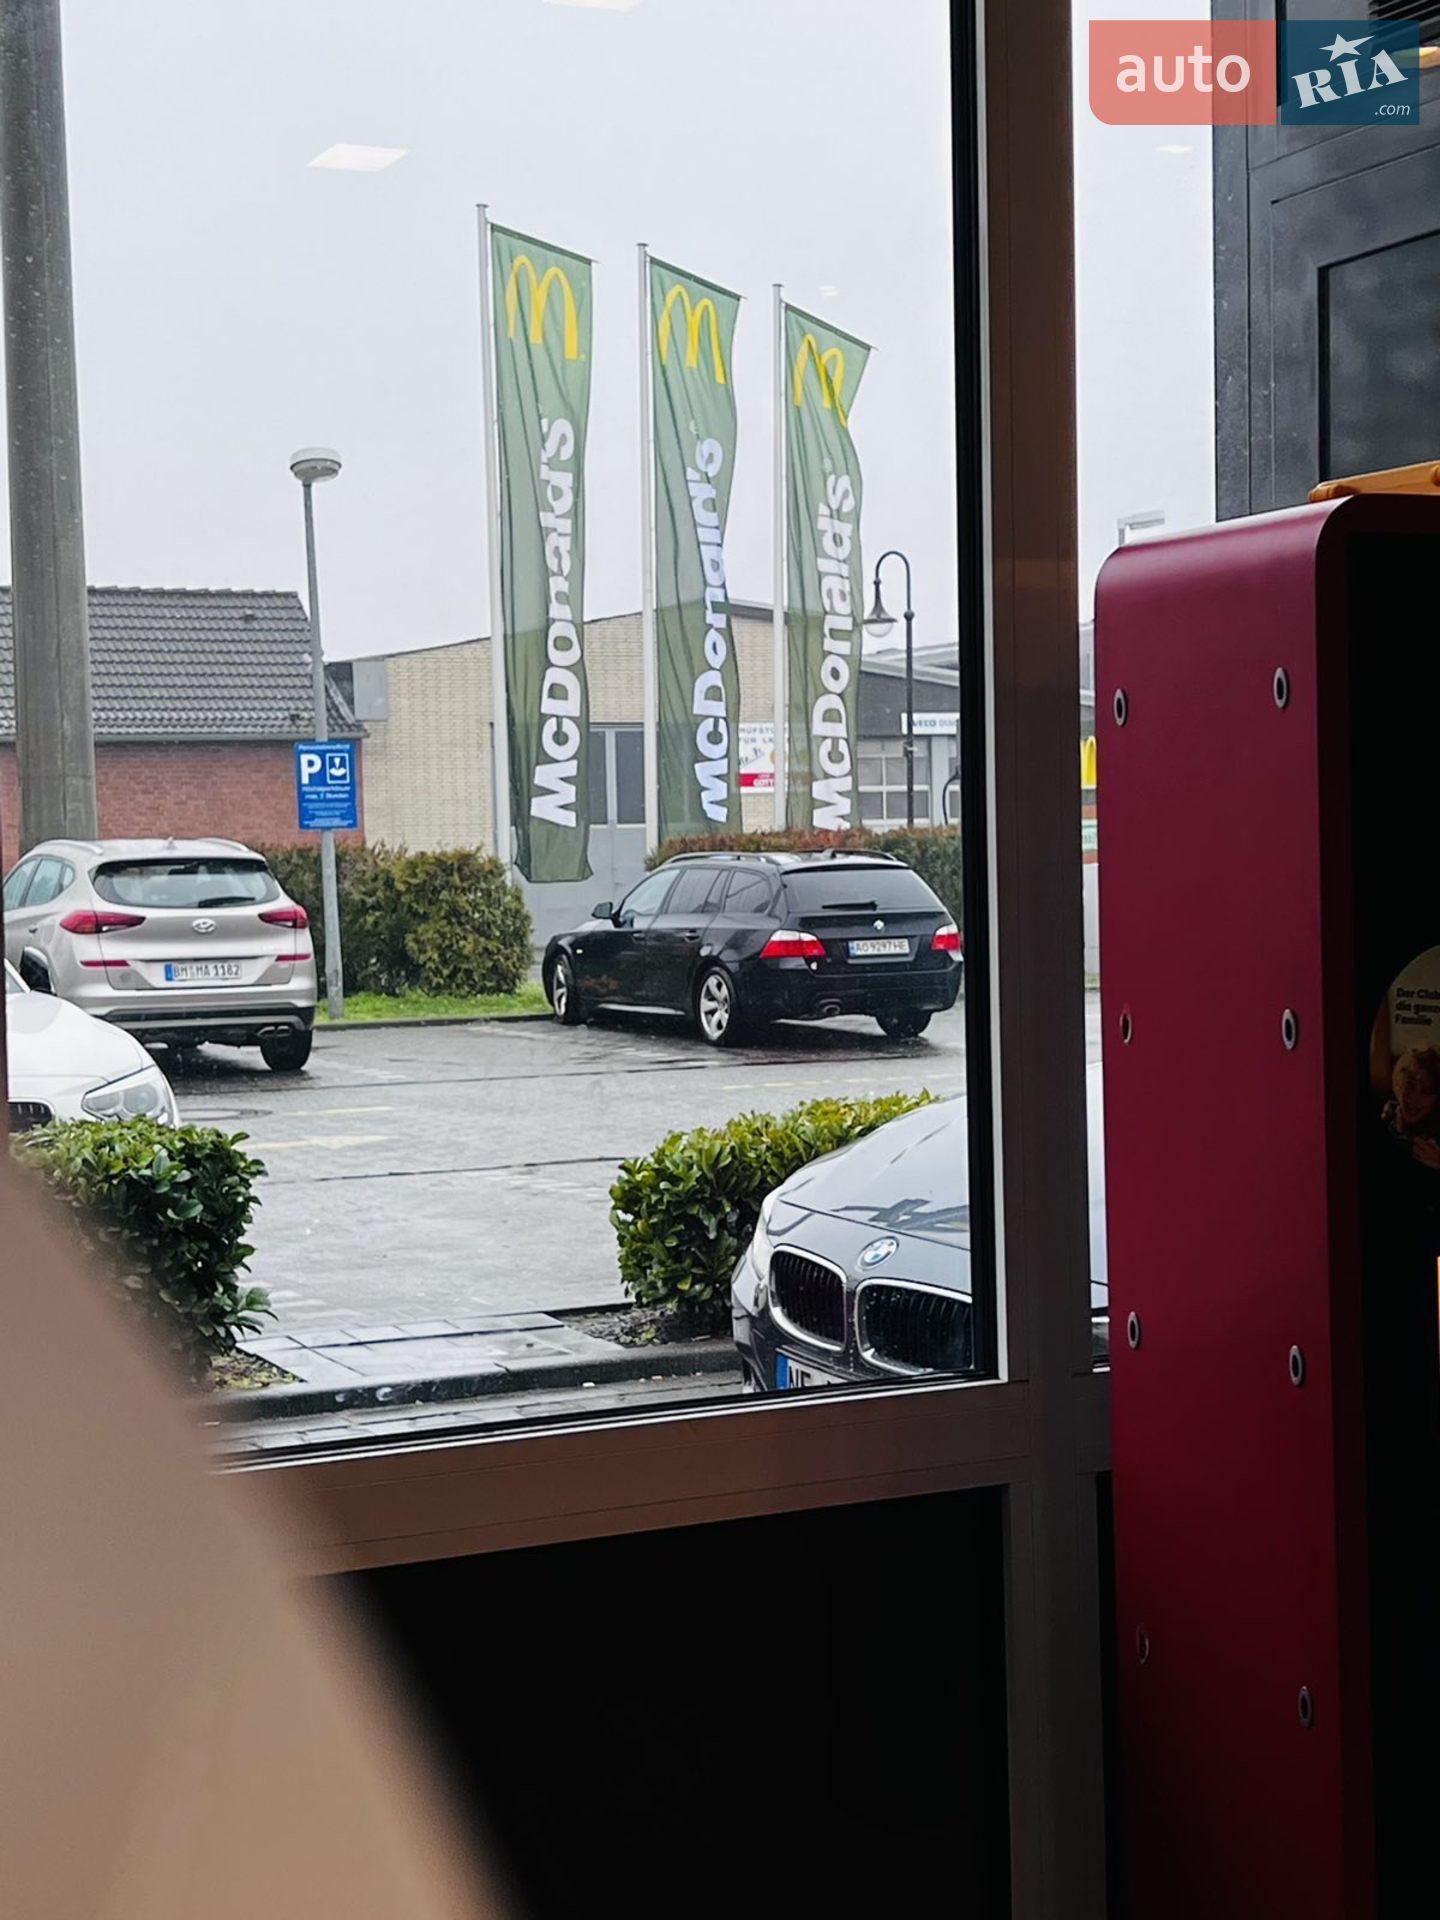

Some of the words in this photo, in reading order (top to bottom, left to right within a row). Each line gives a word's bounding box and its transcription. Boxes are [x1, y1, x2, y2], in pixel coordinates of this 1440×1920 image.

[301, 753, 322, 785] P
[531, 418, 581, 828] McDonald's
[812, 474, 855, 830] McDonald's
